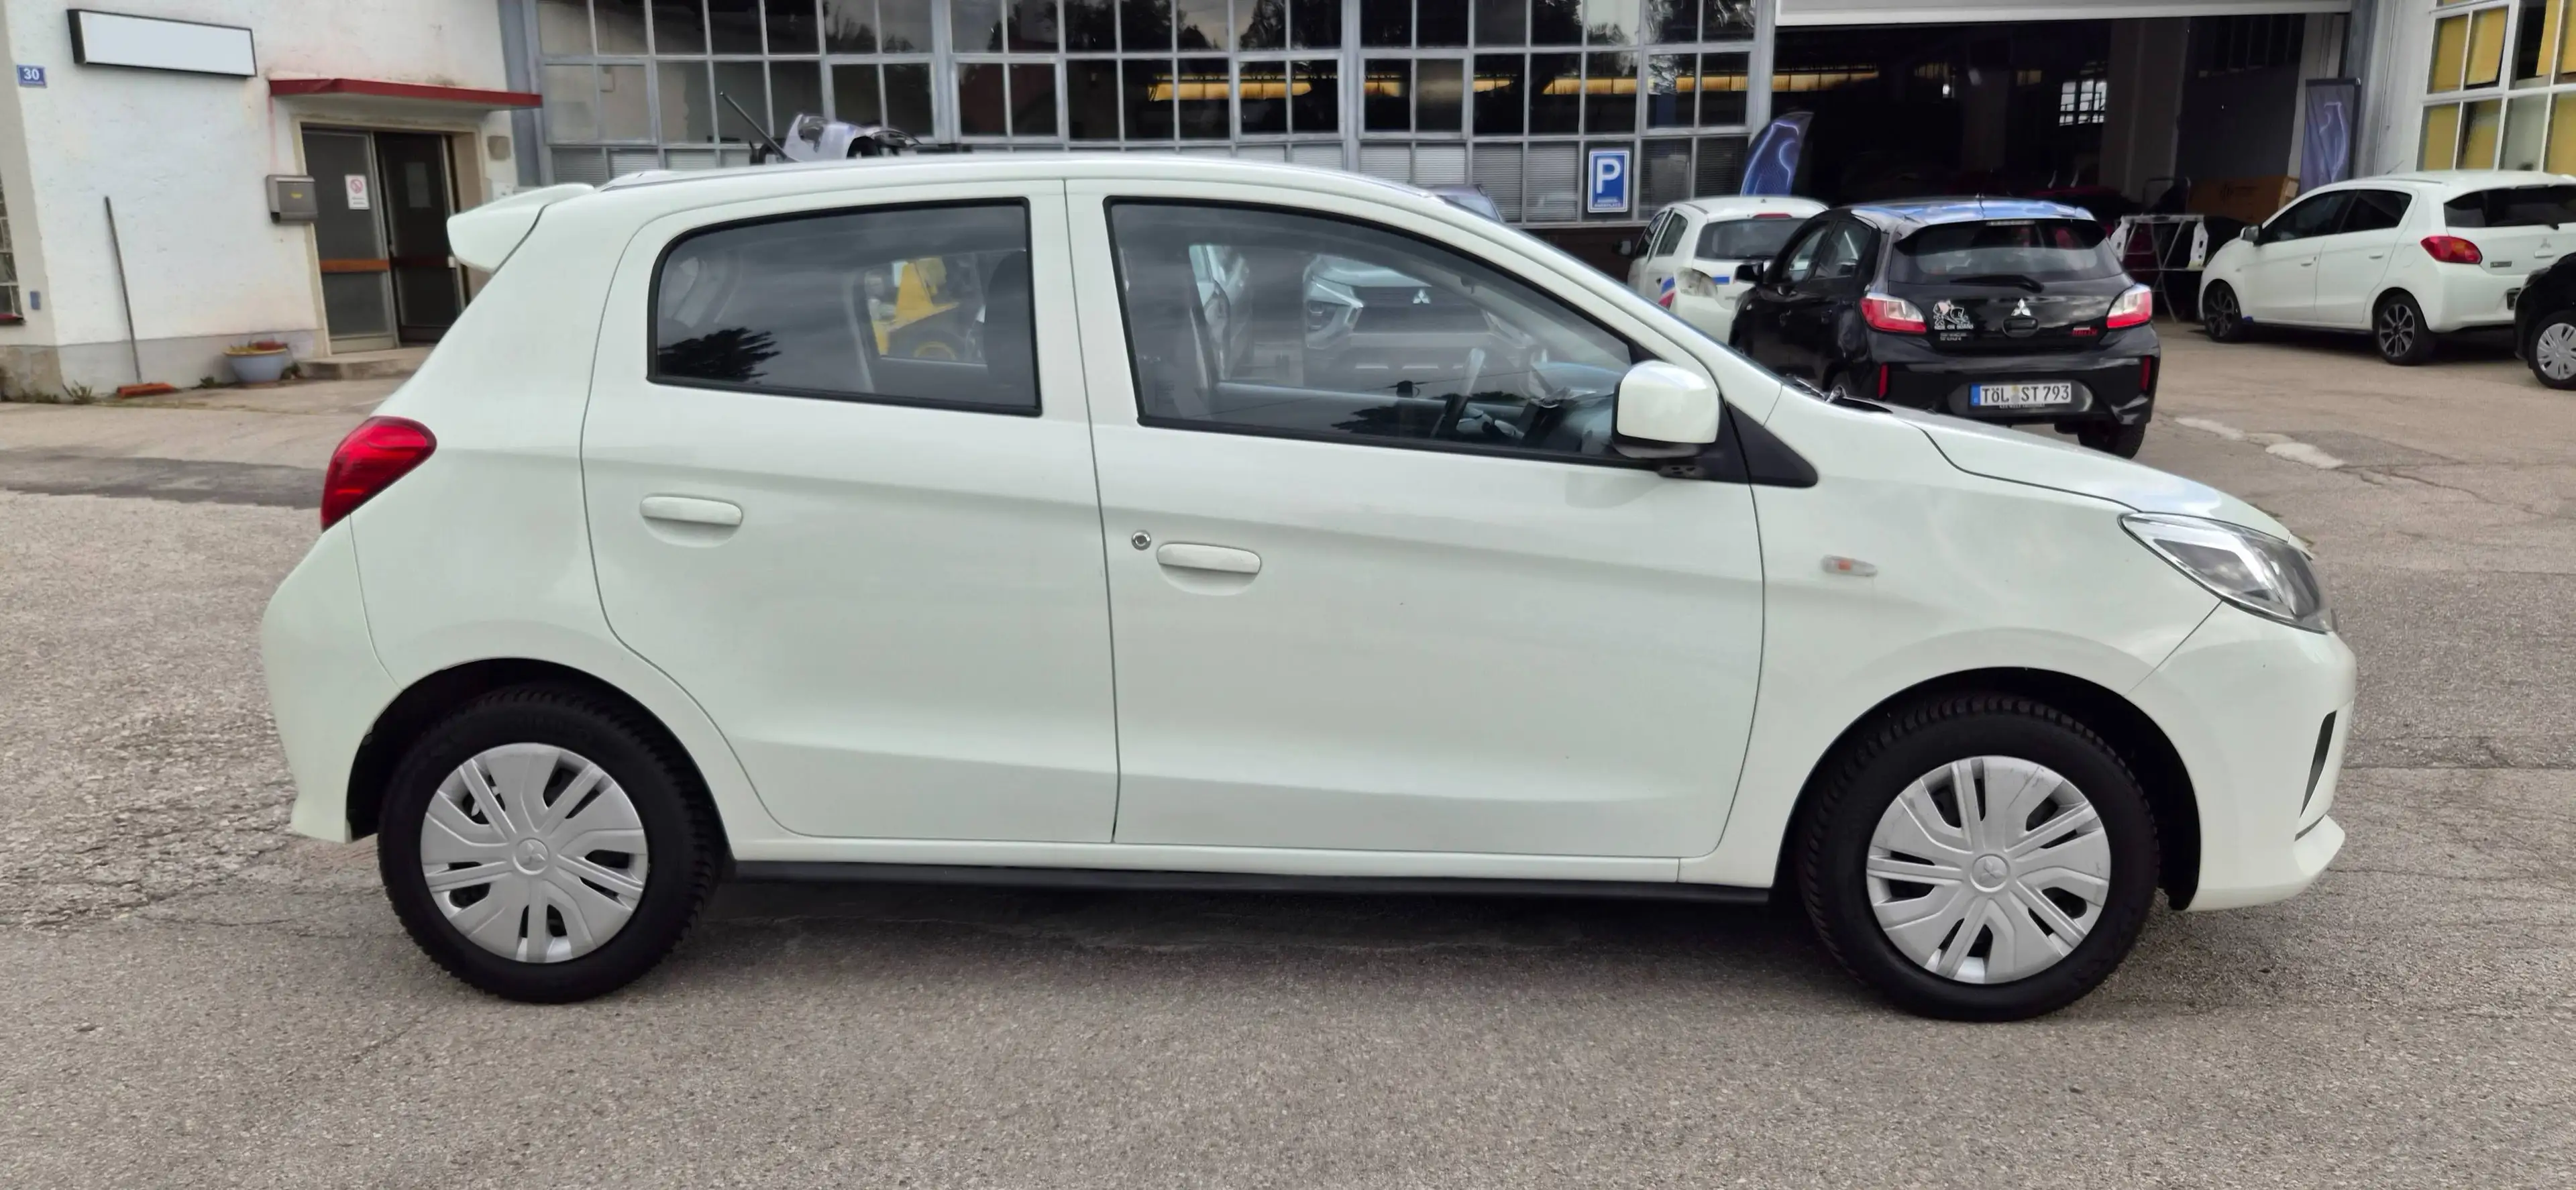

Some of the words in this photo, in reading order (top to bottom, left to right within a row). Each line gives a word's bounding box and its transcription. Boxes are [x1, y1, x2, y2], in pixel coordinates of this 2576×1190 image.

[23, 68, 40, 80] 30
[1597, 158, 1621, 193] P
[1982, 387, 2009, 402] TÖL
[2021, 386, 2039, 402] ST
[2043, 384, 2070, 400] 793
